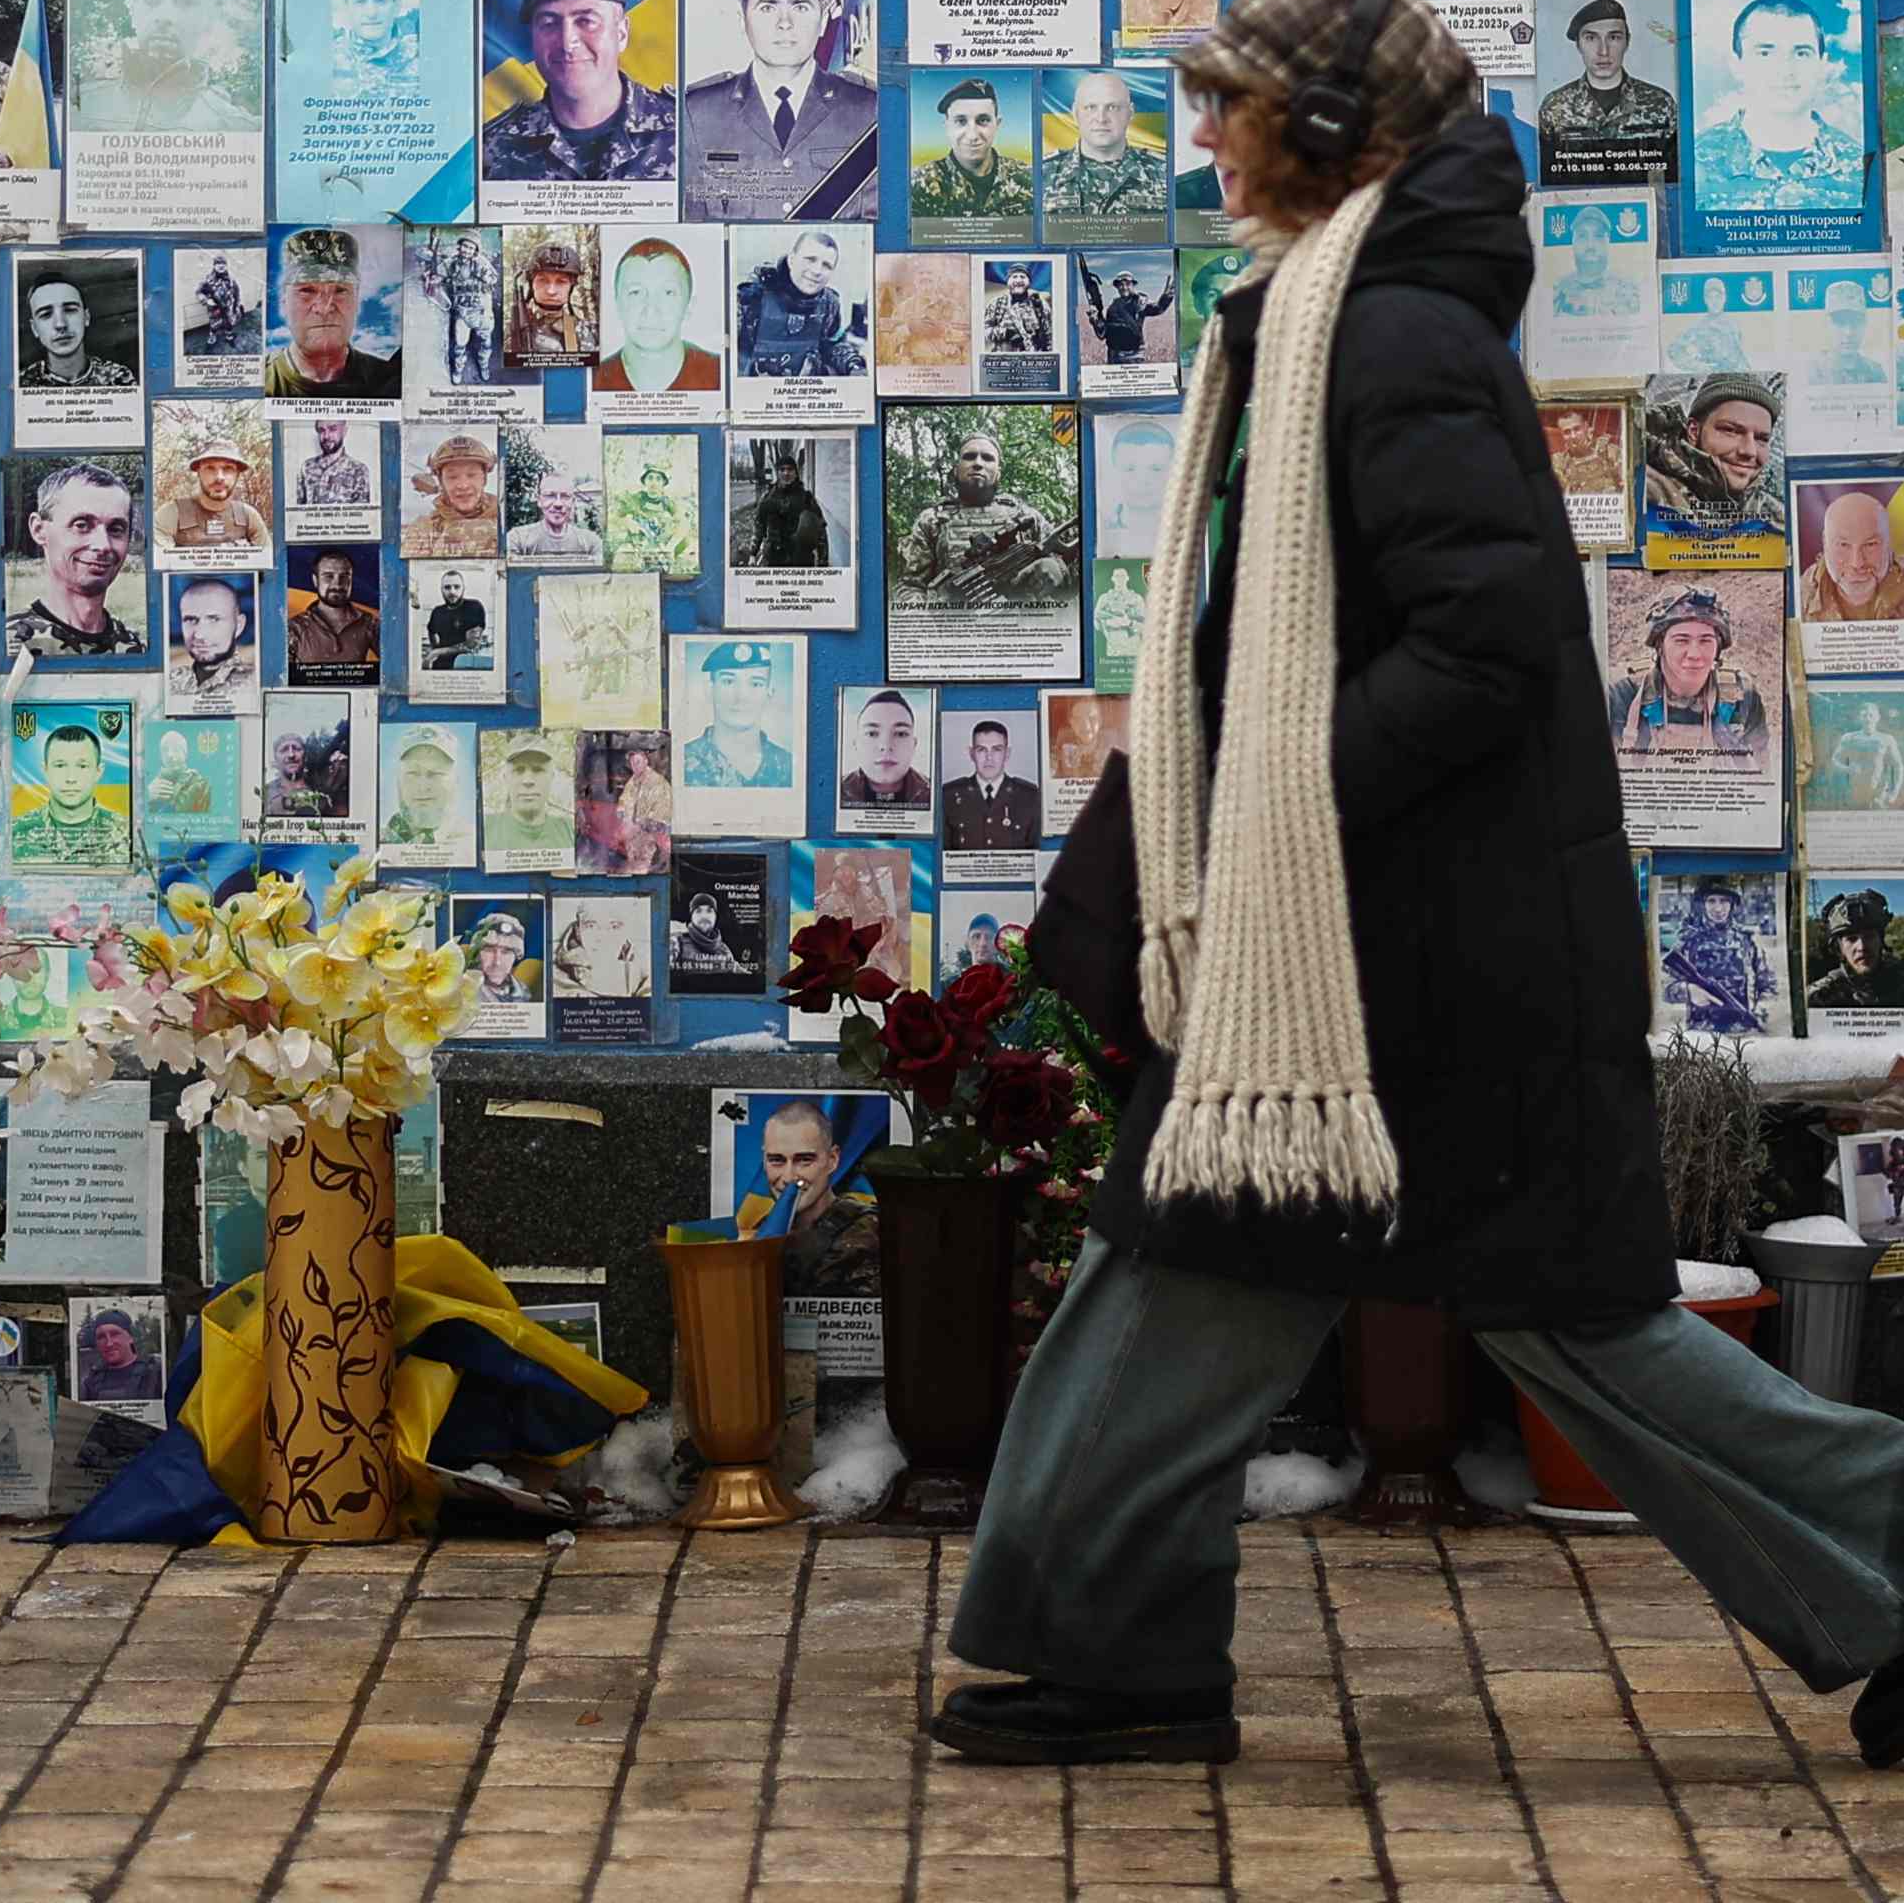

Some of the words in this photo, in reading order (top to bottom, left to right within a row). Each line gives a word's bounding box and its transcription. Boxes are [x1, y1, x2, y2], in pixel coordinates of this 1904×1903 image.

[303, 97, 385, 109] Форманчук
[390, 97, 431, 108] Тарас
[318, 111, 357, 121] Вічна
[361, 111, 416, 121] Пам'ять
[303, 124, 435, 135] 21.09.1965-3.07.2022
[102, 134, 225, 149] ГОЛУБОВСЬКИЙ
[76, 152, 129, 168] Андрій
[134, 152, 256, 167] Володимирович
[1705, 216, 1750, 229] Марзін
[1753, 215, 1787, 228] Юрій
[1790, 215, 1861, 227] Вікторович
